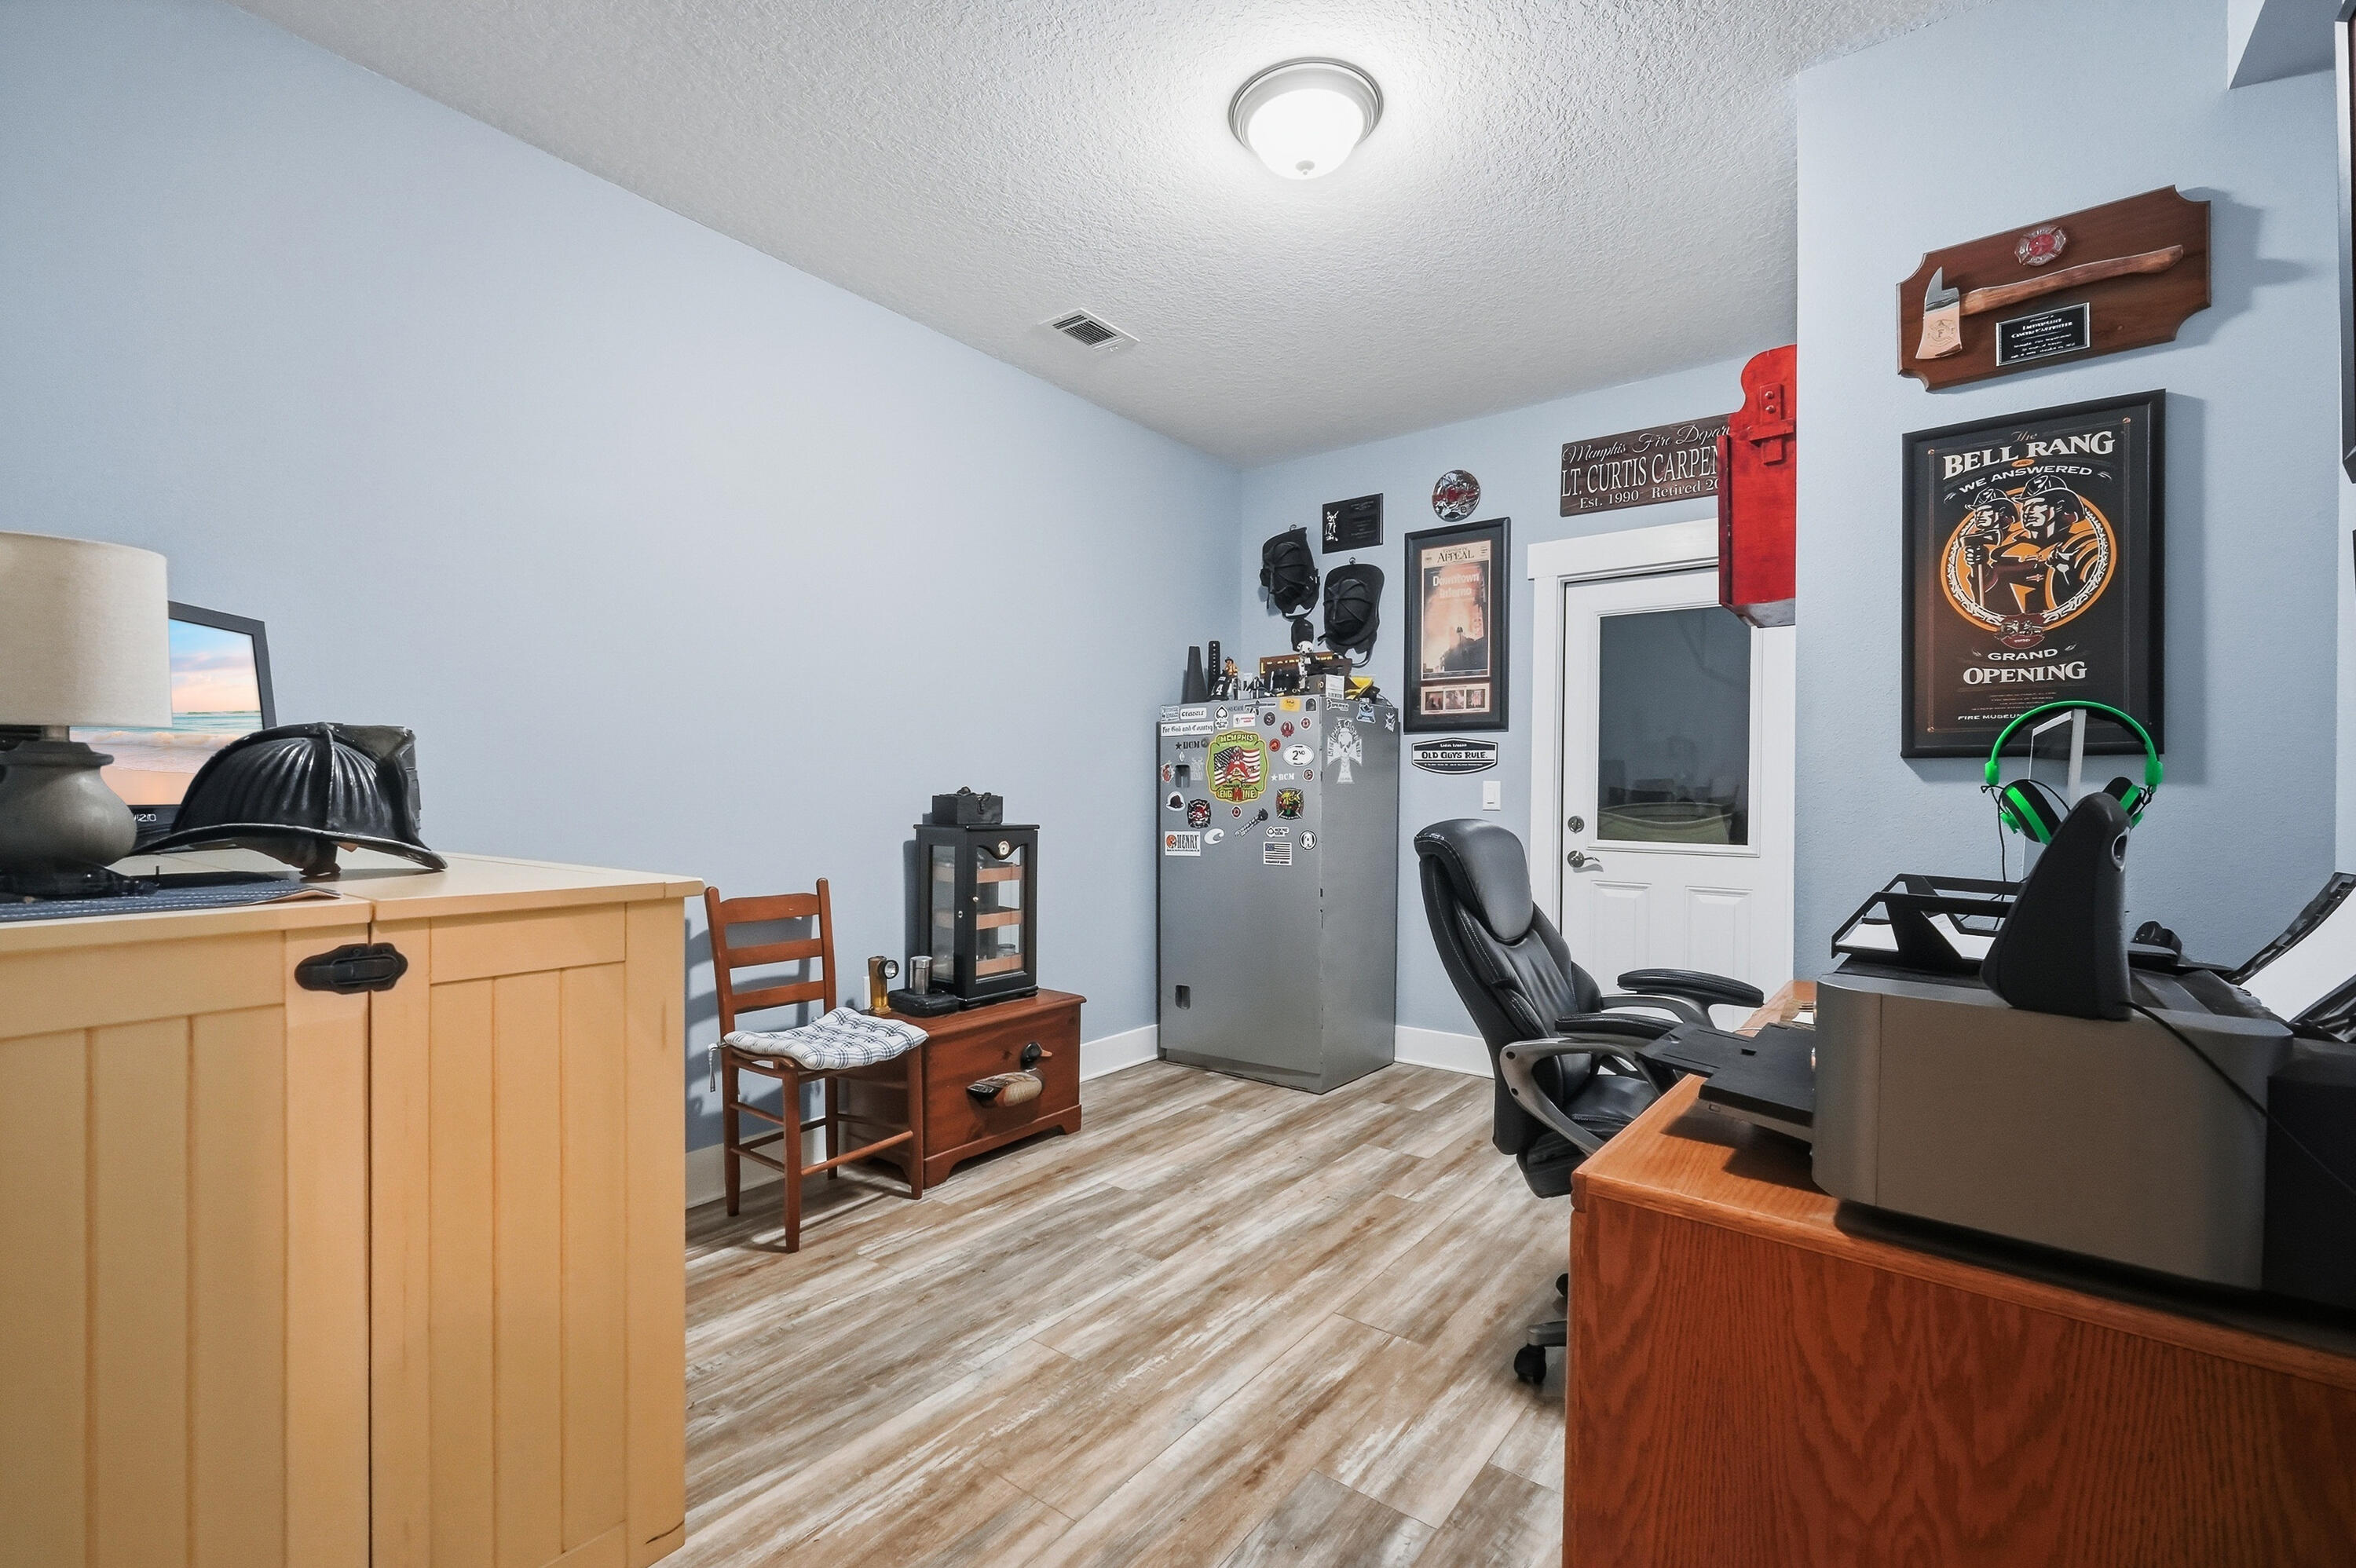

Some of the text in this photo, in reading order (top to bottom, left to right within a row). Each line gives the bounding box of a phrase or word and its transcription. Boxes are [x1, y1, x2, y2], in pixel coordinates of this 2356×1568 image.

[1632, 433, 1671, 453] Fire
[2010, 431, 2038, 442] The
[1942, 431, 2116, 481] BELL RANG
[1561, 468, 1582, 497] LT.
[1587, 456, 1647, 493] CURTIS
[1959, 465, 2093, 493] WE ANSWERED
[1580, 497, 1603, 509] Est.
[1608, 490, 1639, 504] 1990
[1652, 481, 1701, 499] Retired
[1987, 649, 2058, 661] GRAND
[1963, 661, 2087, 685] OPENING
